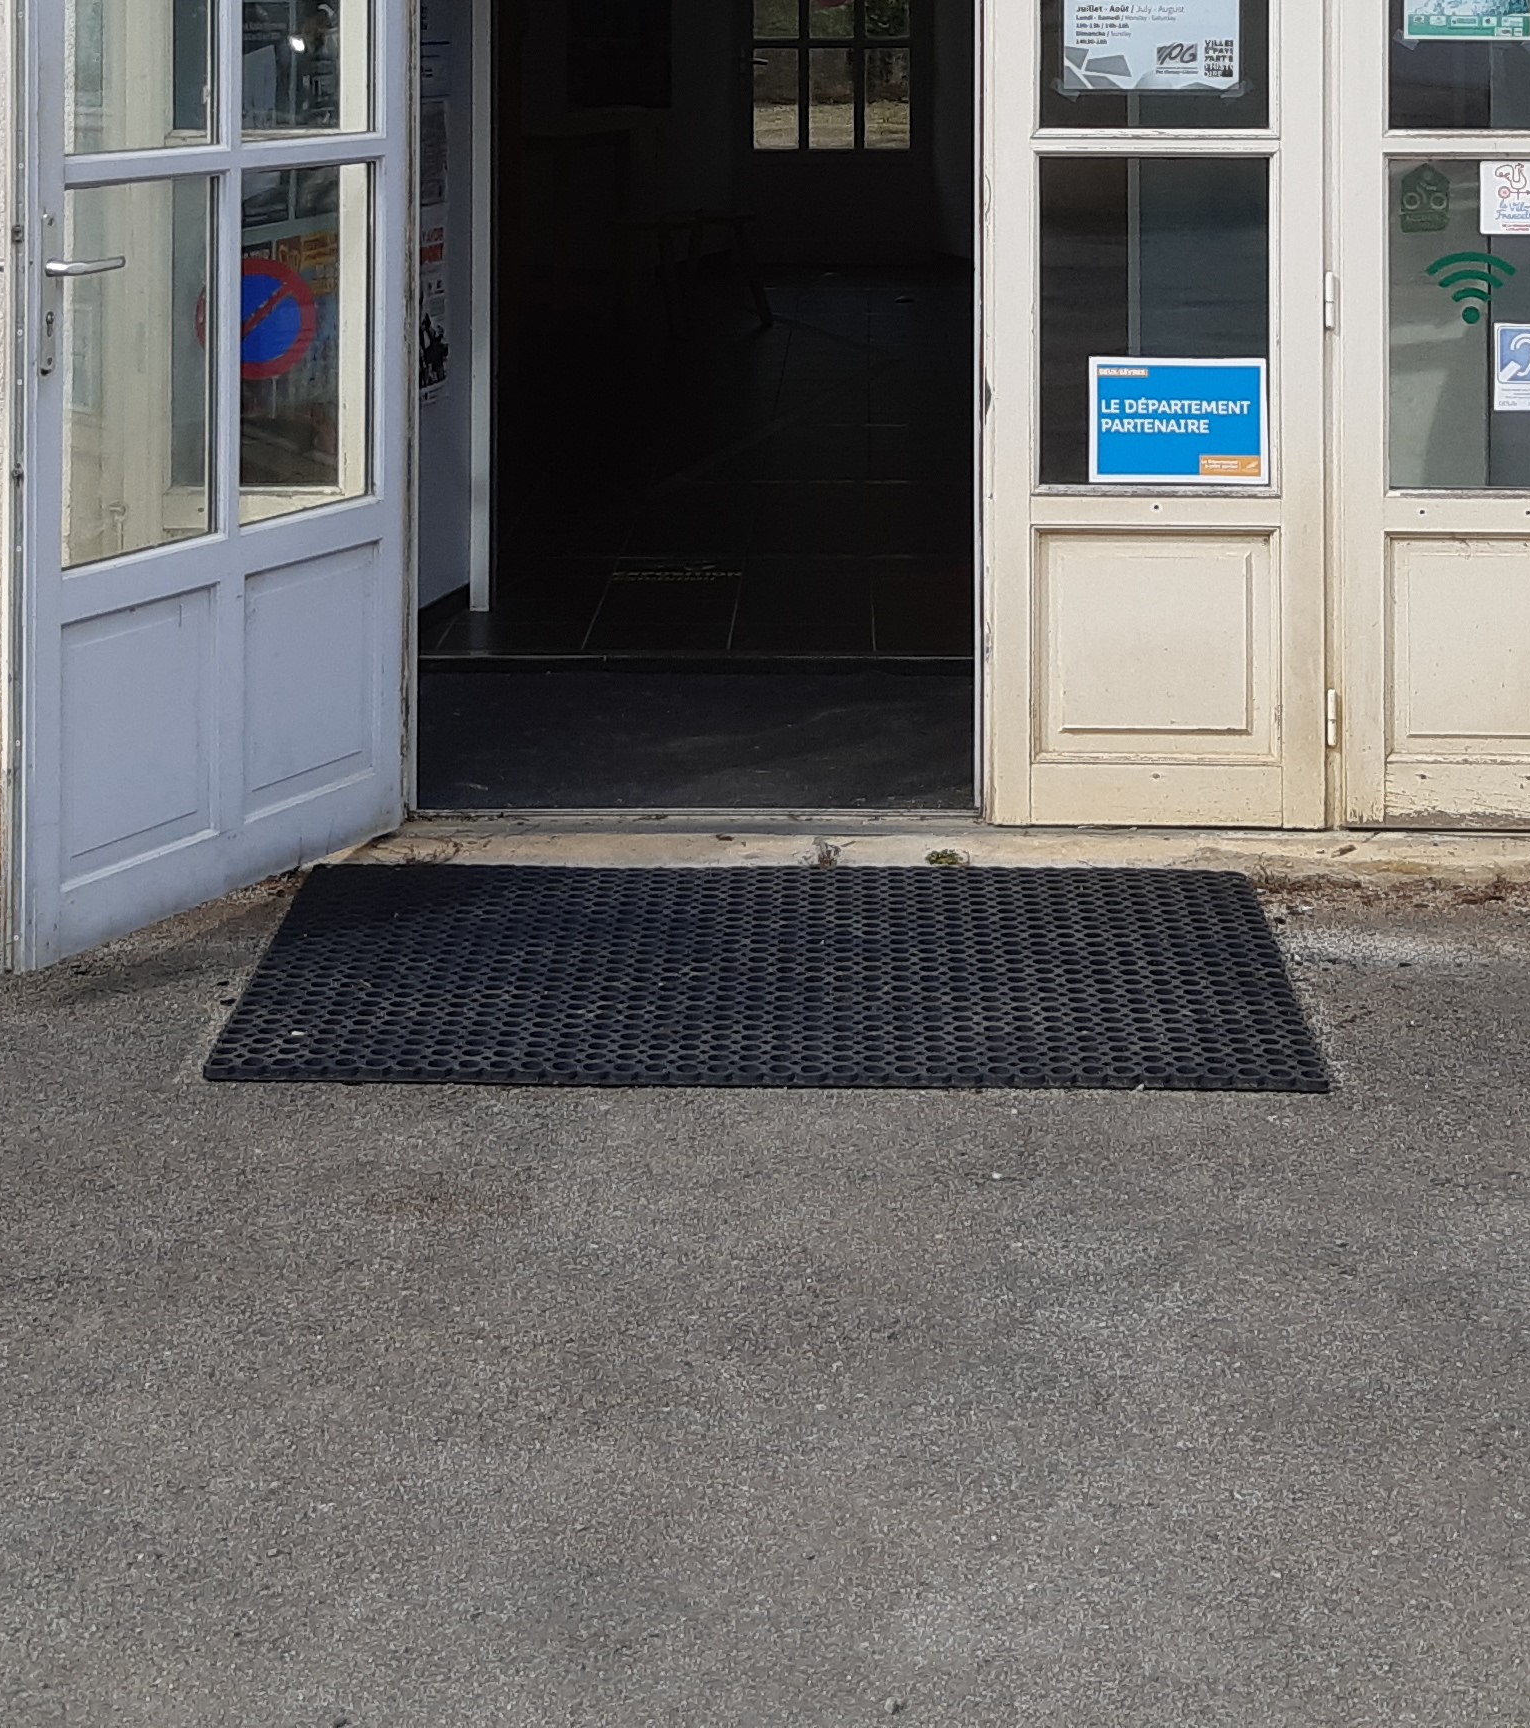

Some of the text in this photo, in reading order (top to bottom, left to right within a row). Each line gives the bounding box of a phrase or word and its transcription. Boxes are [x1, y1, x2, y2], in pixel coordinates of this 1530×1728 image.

[1109, 4, 1129, 12] Août
[1101, 397, 1250, 415] LE DÉPARTEMENT
[1101, 418, 1209, 433] PARTENAIRE
